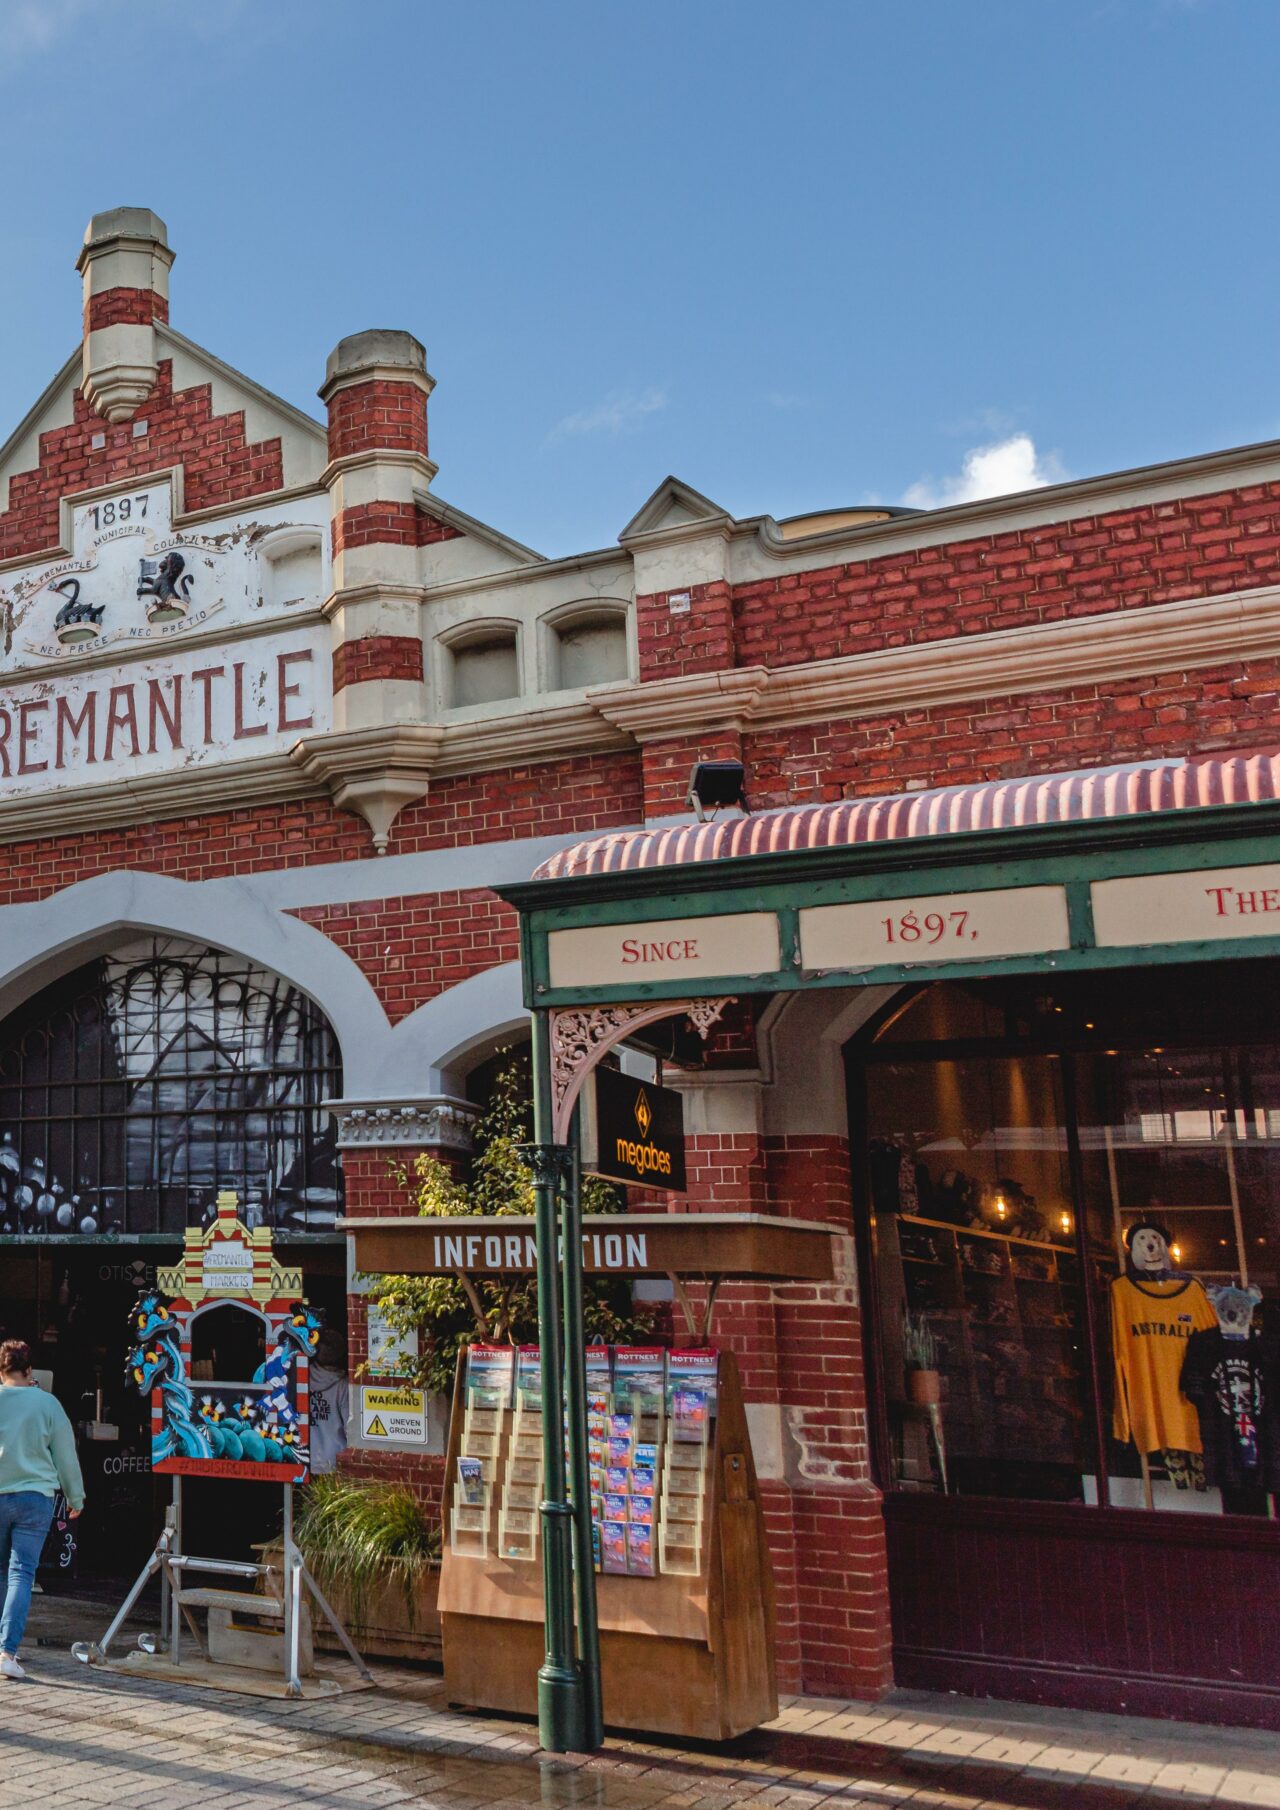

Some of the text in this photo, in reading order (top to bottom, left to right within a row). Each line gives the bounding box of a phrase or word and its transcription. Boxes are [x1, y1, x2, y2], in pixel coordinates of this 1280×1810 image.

[93, 494, 149, 531] 1897
[93, 527, 147, 548] MUNICIPAL
[153, 538, 200, 552] COUNCIL
[39, 560, 92, 583] FREMANTLE
[129, 610, 207, 637] NEC PRETIO
[40, 635, 109, 656] NEC PRECE
[1205, 887, 1280, 917] THE
[881, 910, 979, 945] 1897,
[621, 939, 700, 964] SINCE
[616, 1138, 671, 1174] megabes
[210, 1275, 249, 1288] MARKETS
[472, 1351, 510, 1359] ROTTNEST
[617, 1353, 659, 1361] ROTTNEST
[671, 1355, 714, 1363] ROTTNEST
[368, 1394, 420, 1407] WARNING
[389, 1426, 422, 1436] GROUND
[390, 1418, 421, 1427] UNEVEN
[103, 1456, 151, 1475] COFFEE
